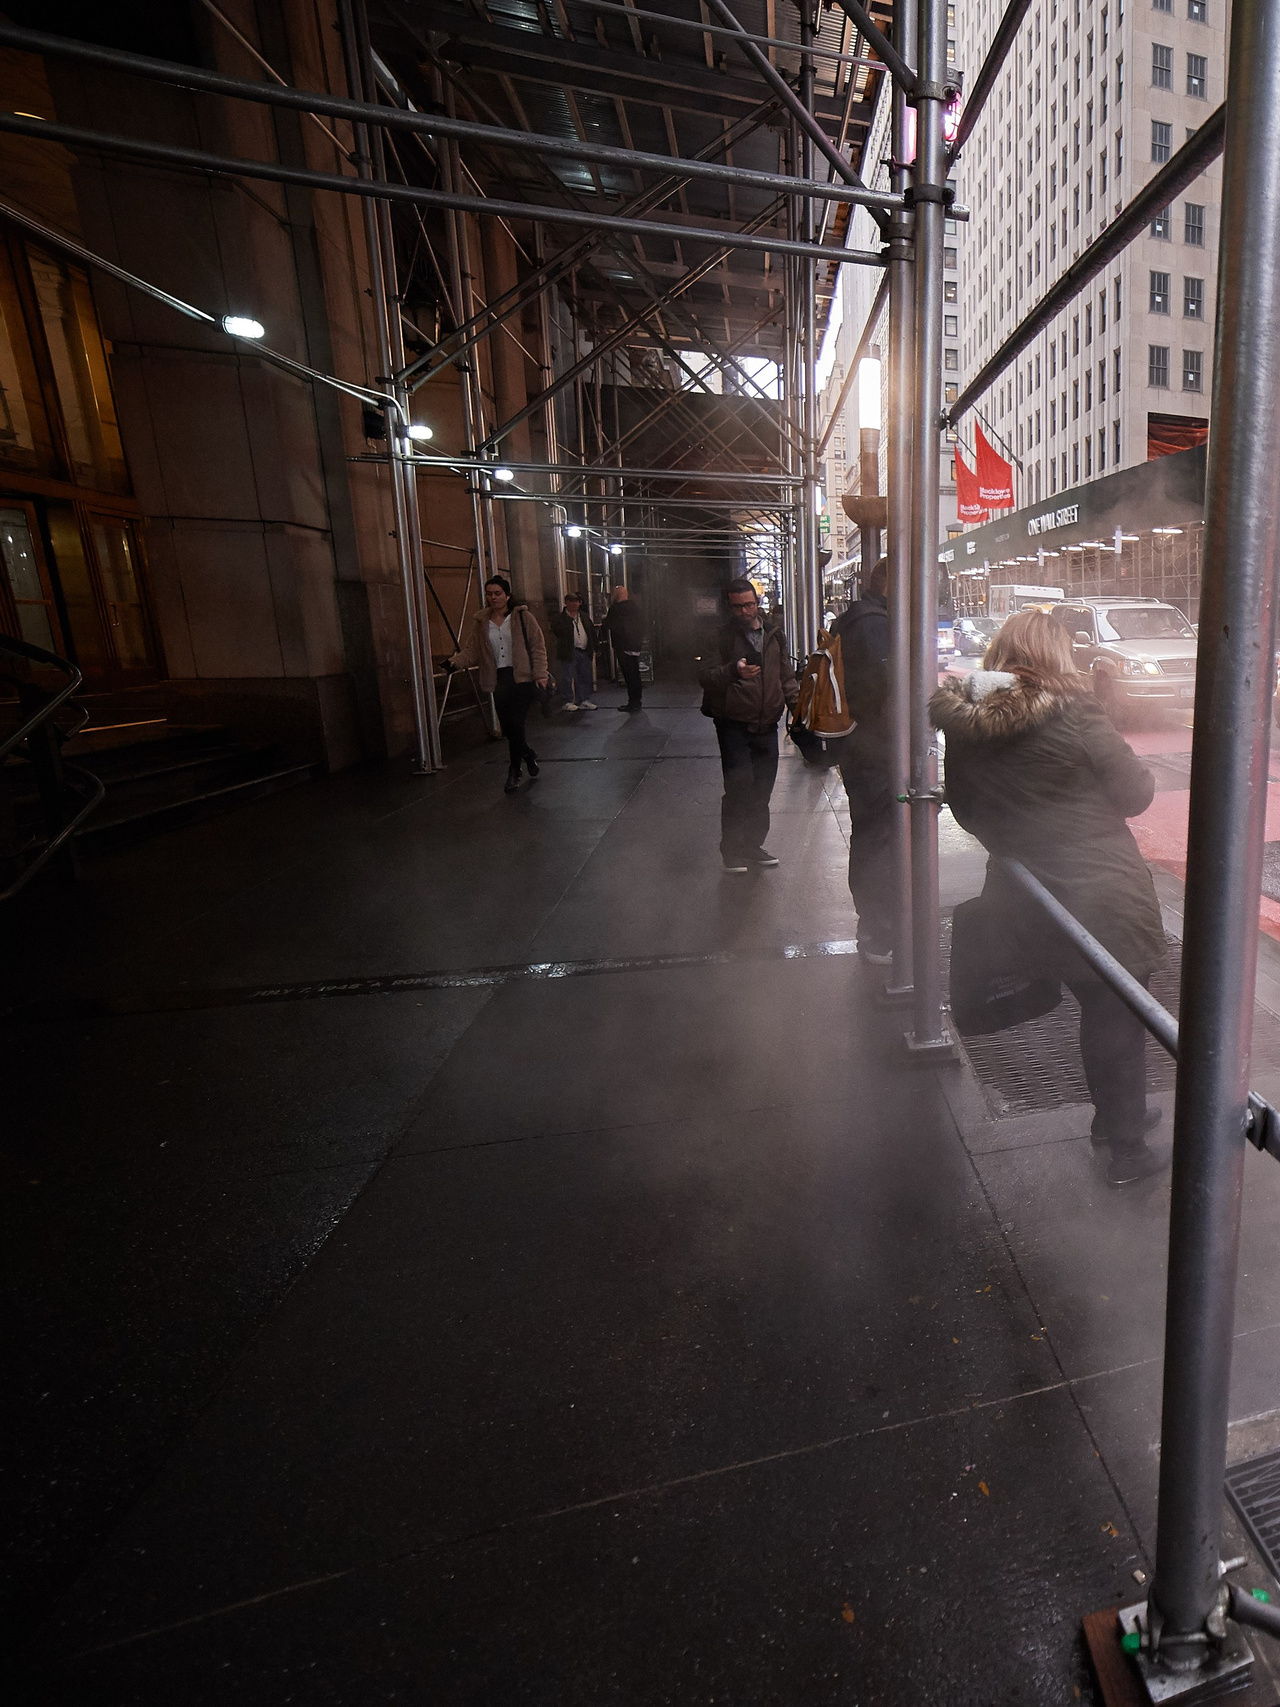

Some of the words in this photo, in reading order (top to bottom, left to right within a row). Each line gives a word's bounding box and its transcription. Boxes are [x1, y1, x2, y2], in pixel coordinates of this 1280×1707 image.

[1028, 517, 1041, 537] ONE
[1040, 511, 1057, 533] WALL
[1056, 503, 1079, 528] STREET
